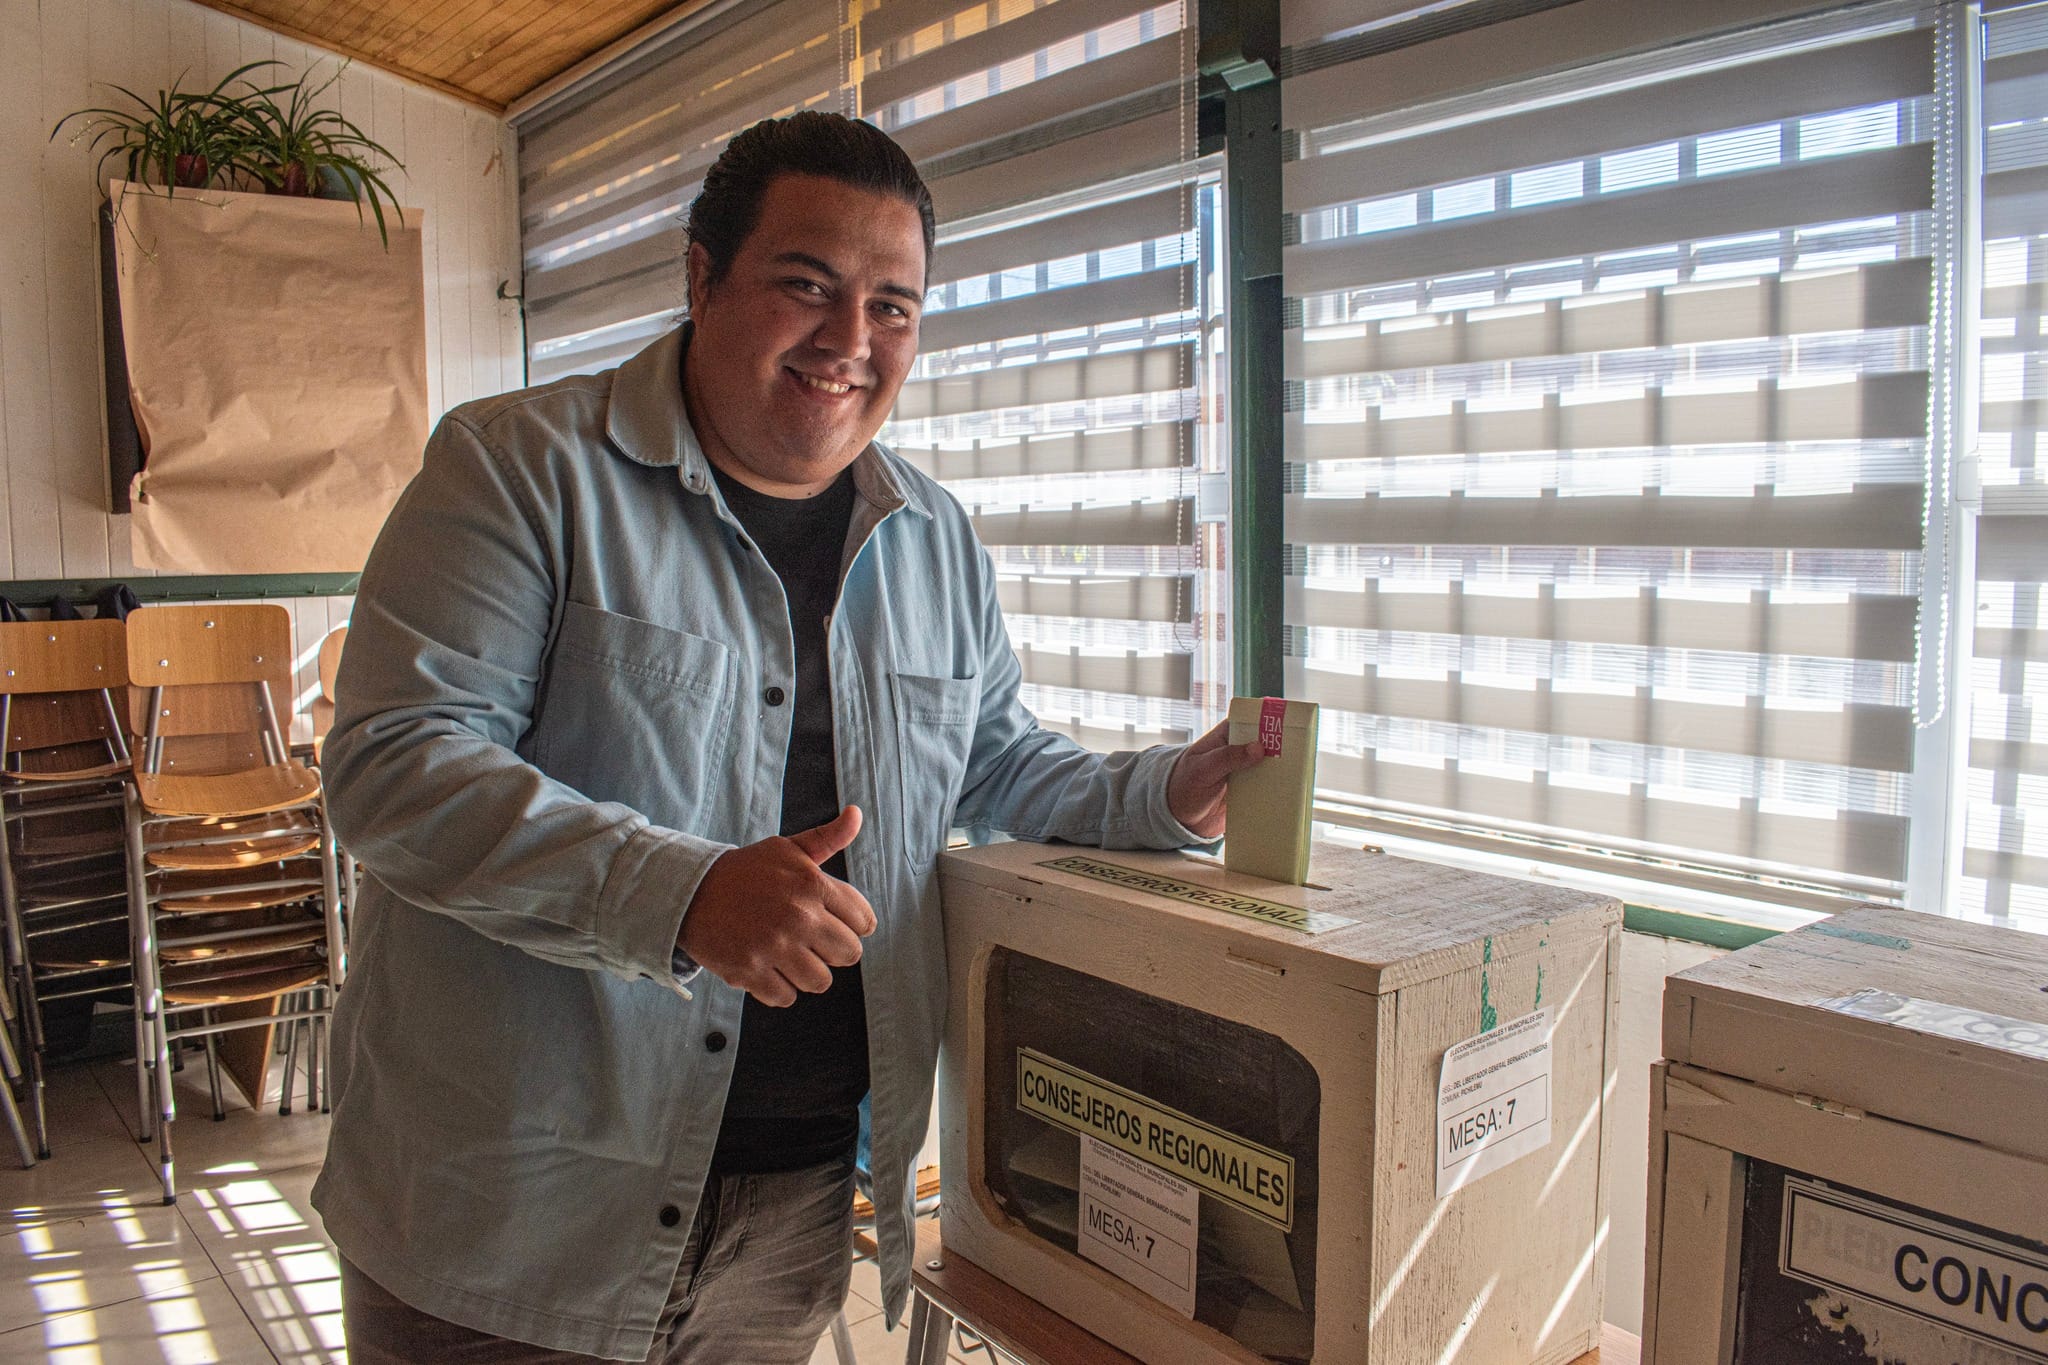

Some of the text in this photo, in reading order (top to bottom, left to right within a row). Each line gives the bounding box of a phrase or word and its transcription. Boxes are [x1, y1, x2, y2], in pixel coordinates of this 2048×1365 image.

[1263, 715, 1282, 733] VEL
[1053, 857, 1187, 894] CONSEJEROS
[1023, 1070, 1285, 1207] CONSEJEROS REGIONALES
[1449, 1098, 1517, 1153] MESA: 7
[1089, 1204, 1155, 1258] MESA: 7
[1894, 1244, 2048, 1333] CONC
